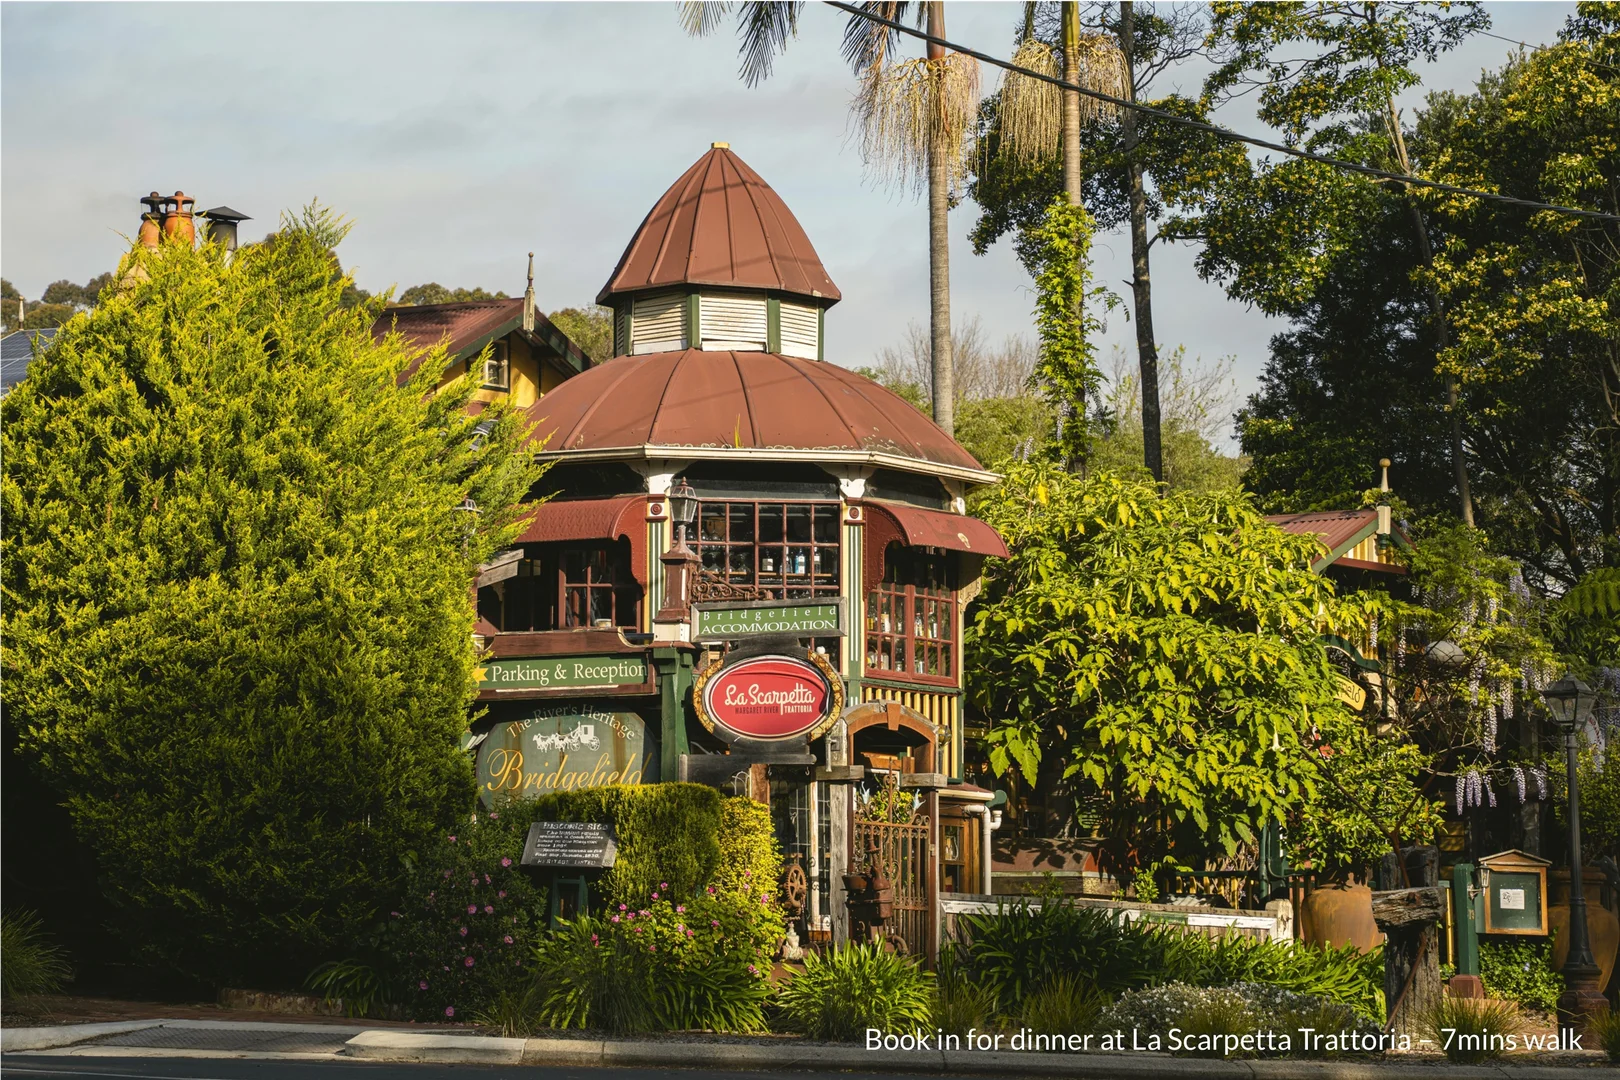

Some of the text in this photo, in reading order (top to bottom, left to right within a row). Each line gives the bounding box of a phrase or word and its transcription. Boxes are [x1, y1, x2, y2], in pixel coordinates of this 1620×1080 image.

[703, 606, 836, 621] Bridgefield
[701, 620, 836, 634] ACCOMMODATION
[491, 661, 648, 686] Parking & Reception
[724, 682, 815, 716] La Scarpetta
[735, 705, 779, 715] MARGARET RIVER
[784, 704, 813, 713] TRATTORIA
[506, 703, 635, 741] The River's Heritage
